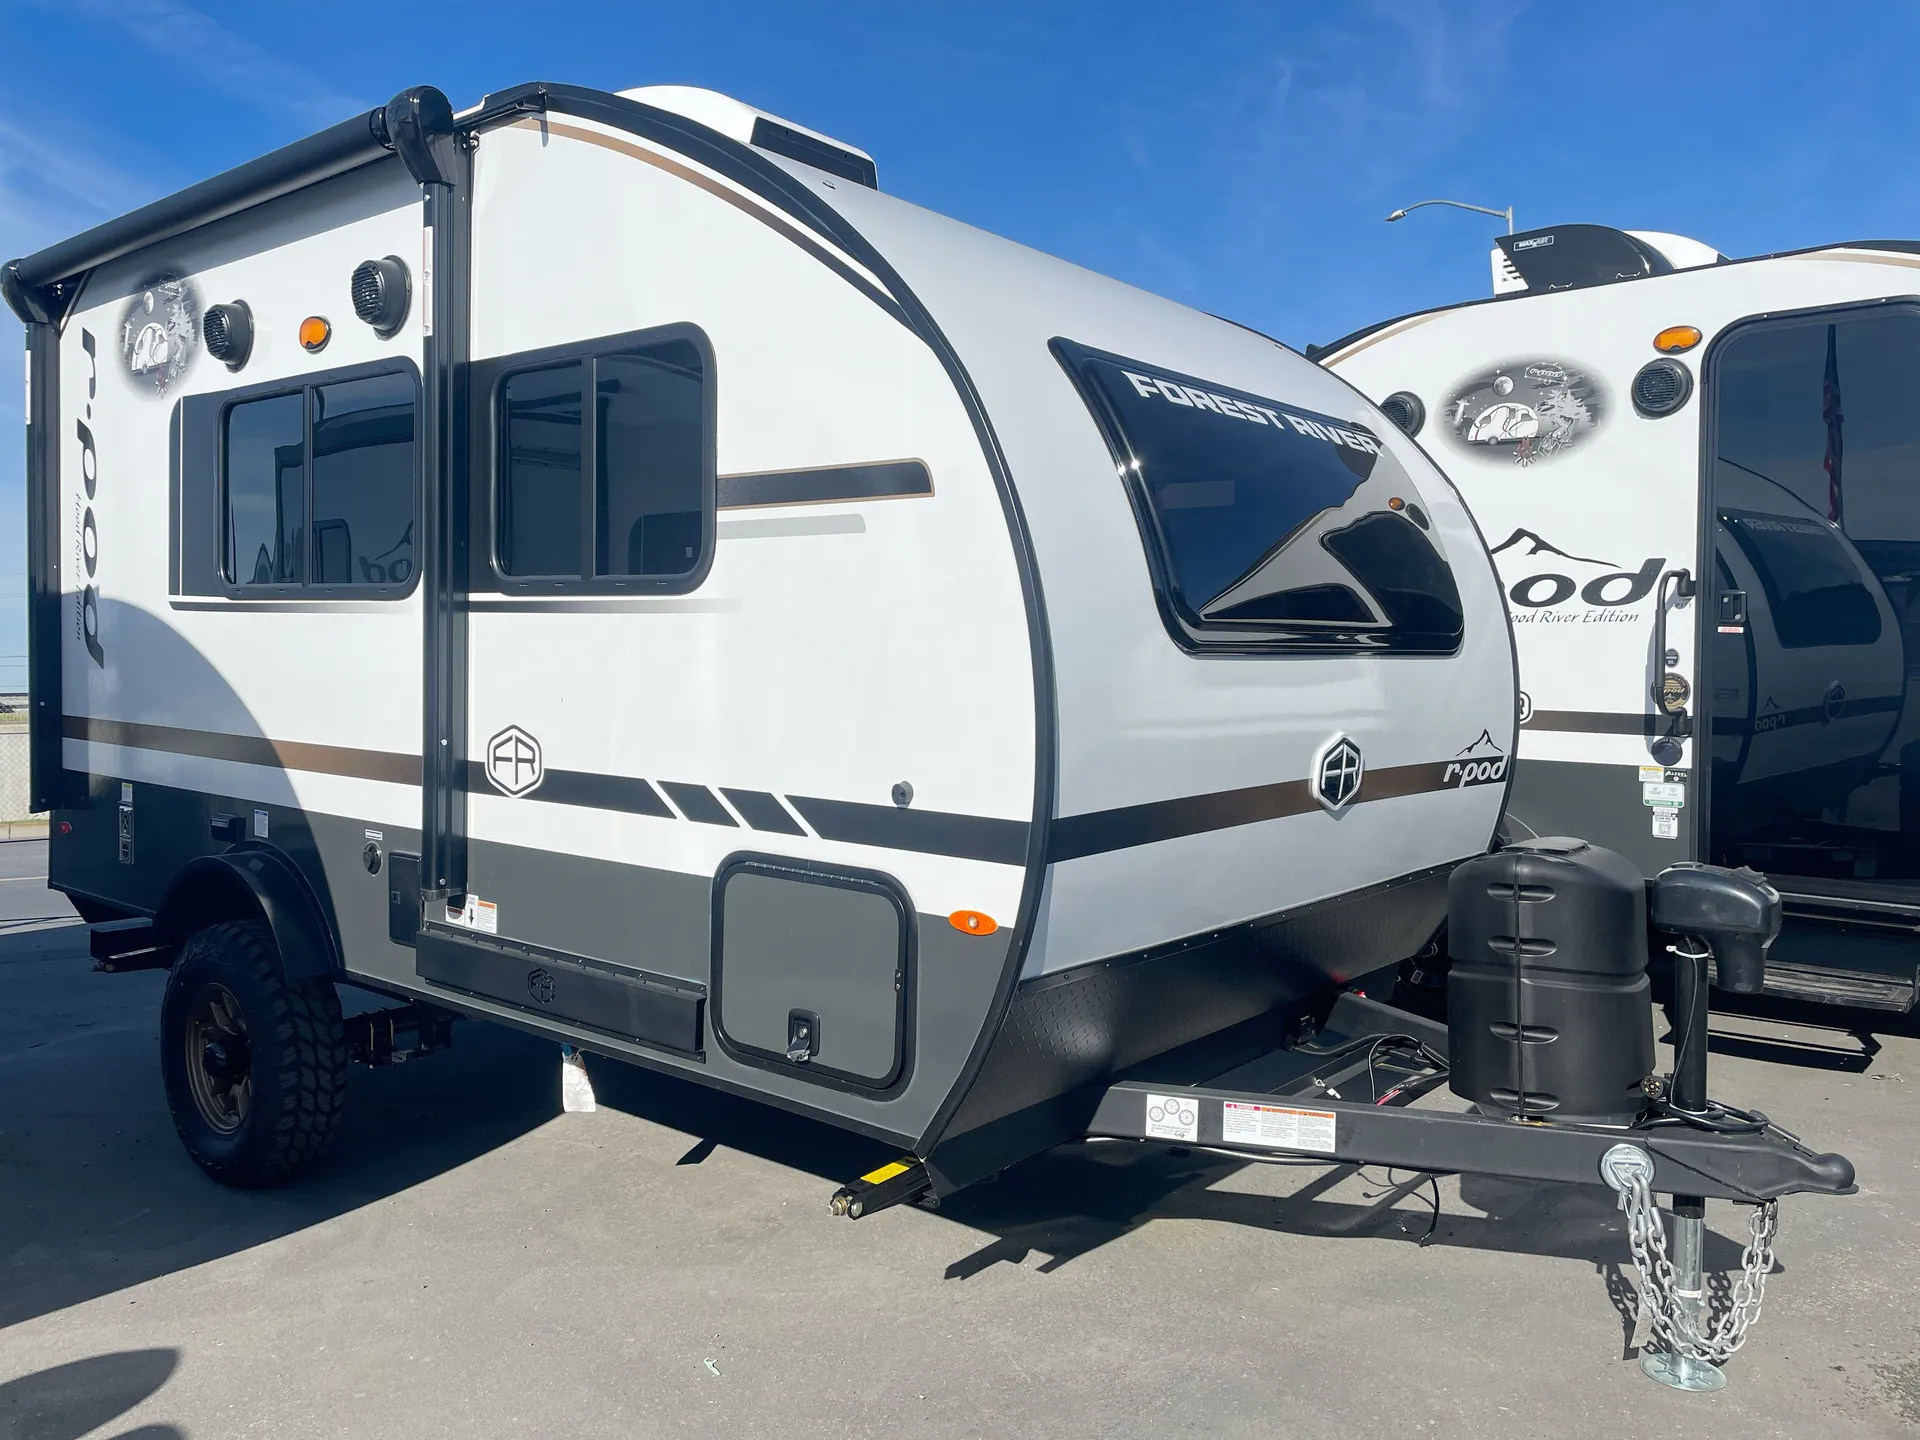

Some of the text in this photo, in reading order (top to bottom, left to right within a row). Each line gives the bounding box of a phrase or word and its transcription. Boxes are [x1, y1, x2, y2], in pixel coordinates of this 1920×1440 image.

[1121, 370, 1385, 458] FOREST RIVER
[1508, 558, 1667, 608] od
[1508, 609, 1640, 624] ood River Edition
